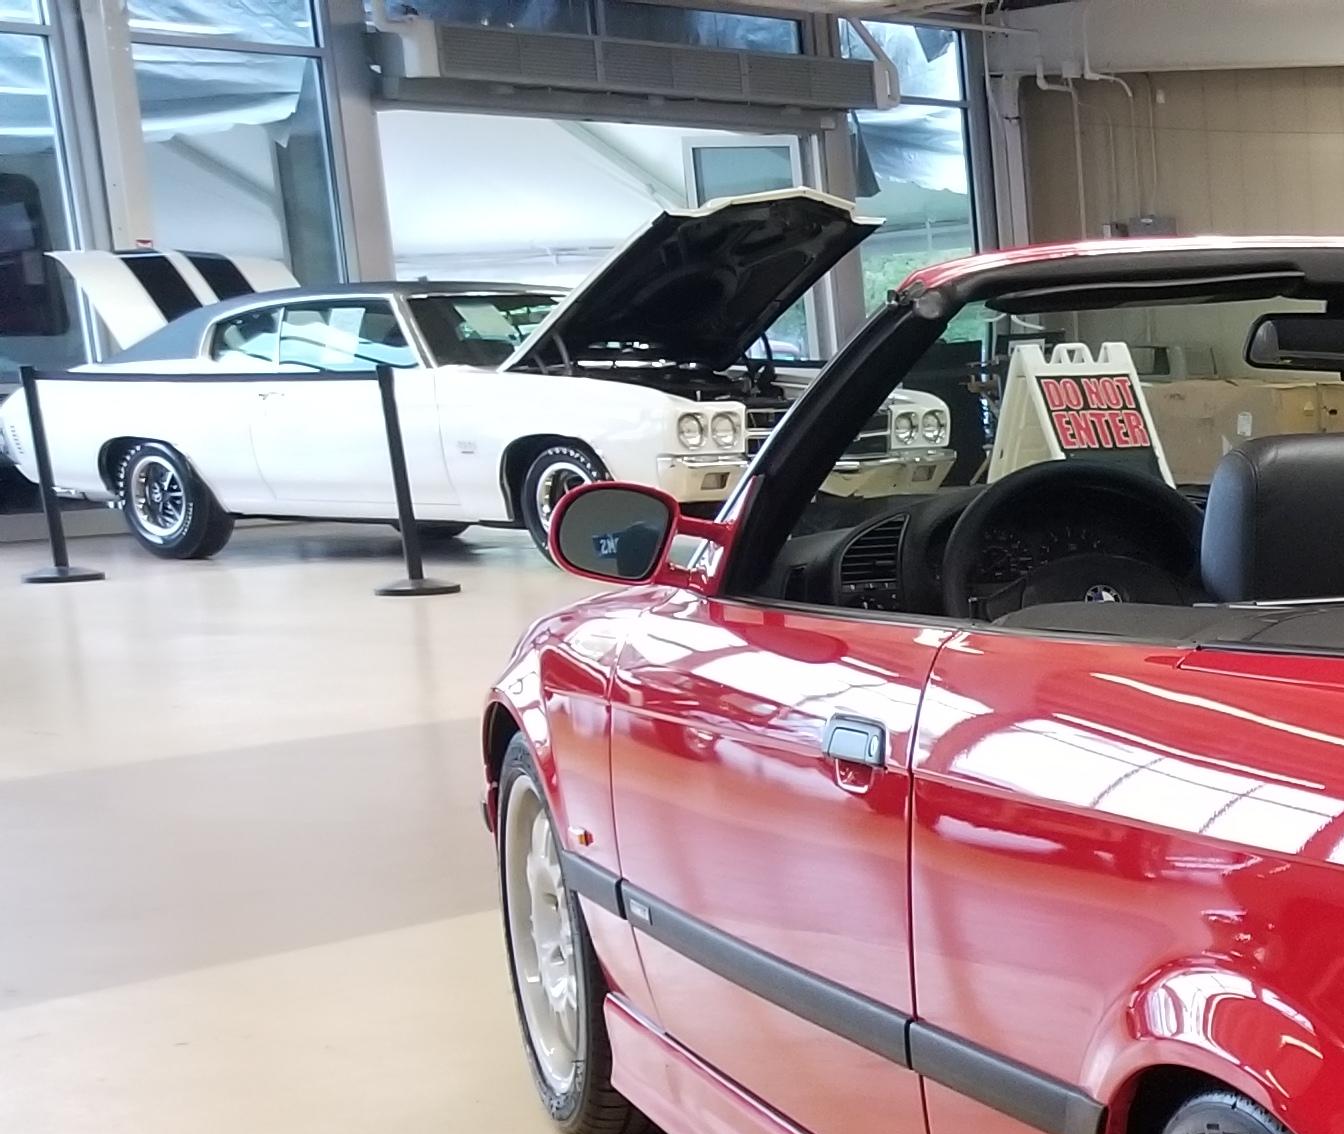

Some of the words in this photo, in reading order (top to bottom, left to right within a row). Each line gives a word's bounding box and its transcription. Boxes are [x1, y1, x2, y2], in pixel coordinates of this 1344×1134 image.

[1041, 378, 1084, 410] DO
[1081, 377, 1136, 409] NOT
[1052, 411, 1151, 449] ENTER
